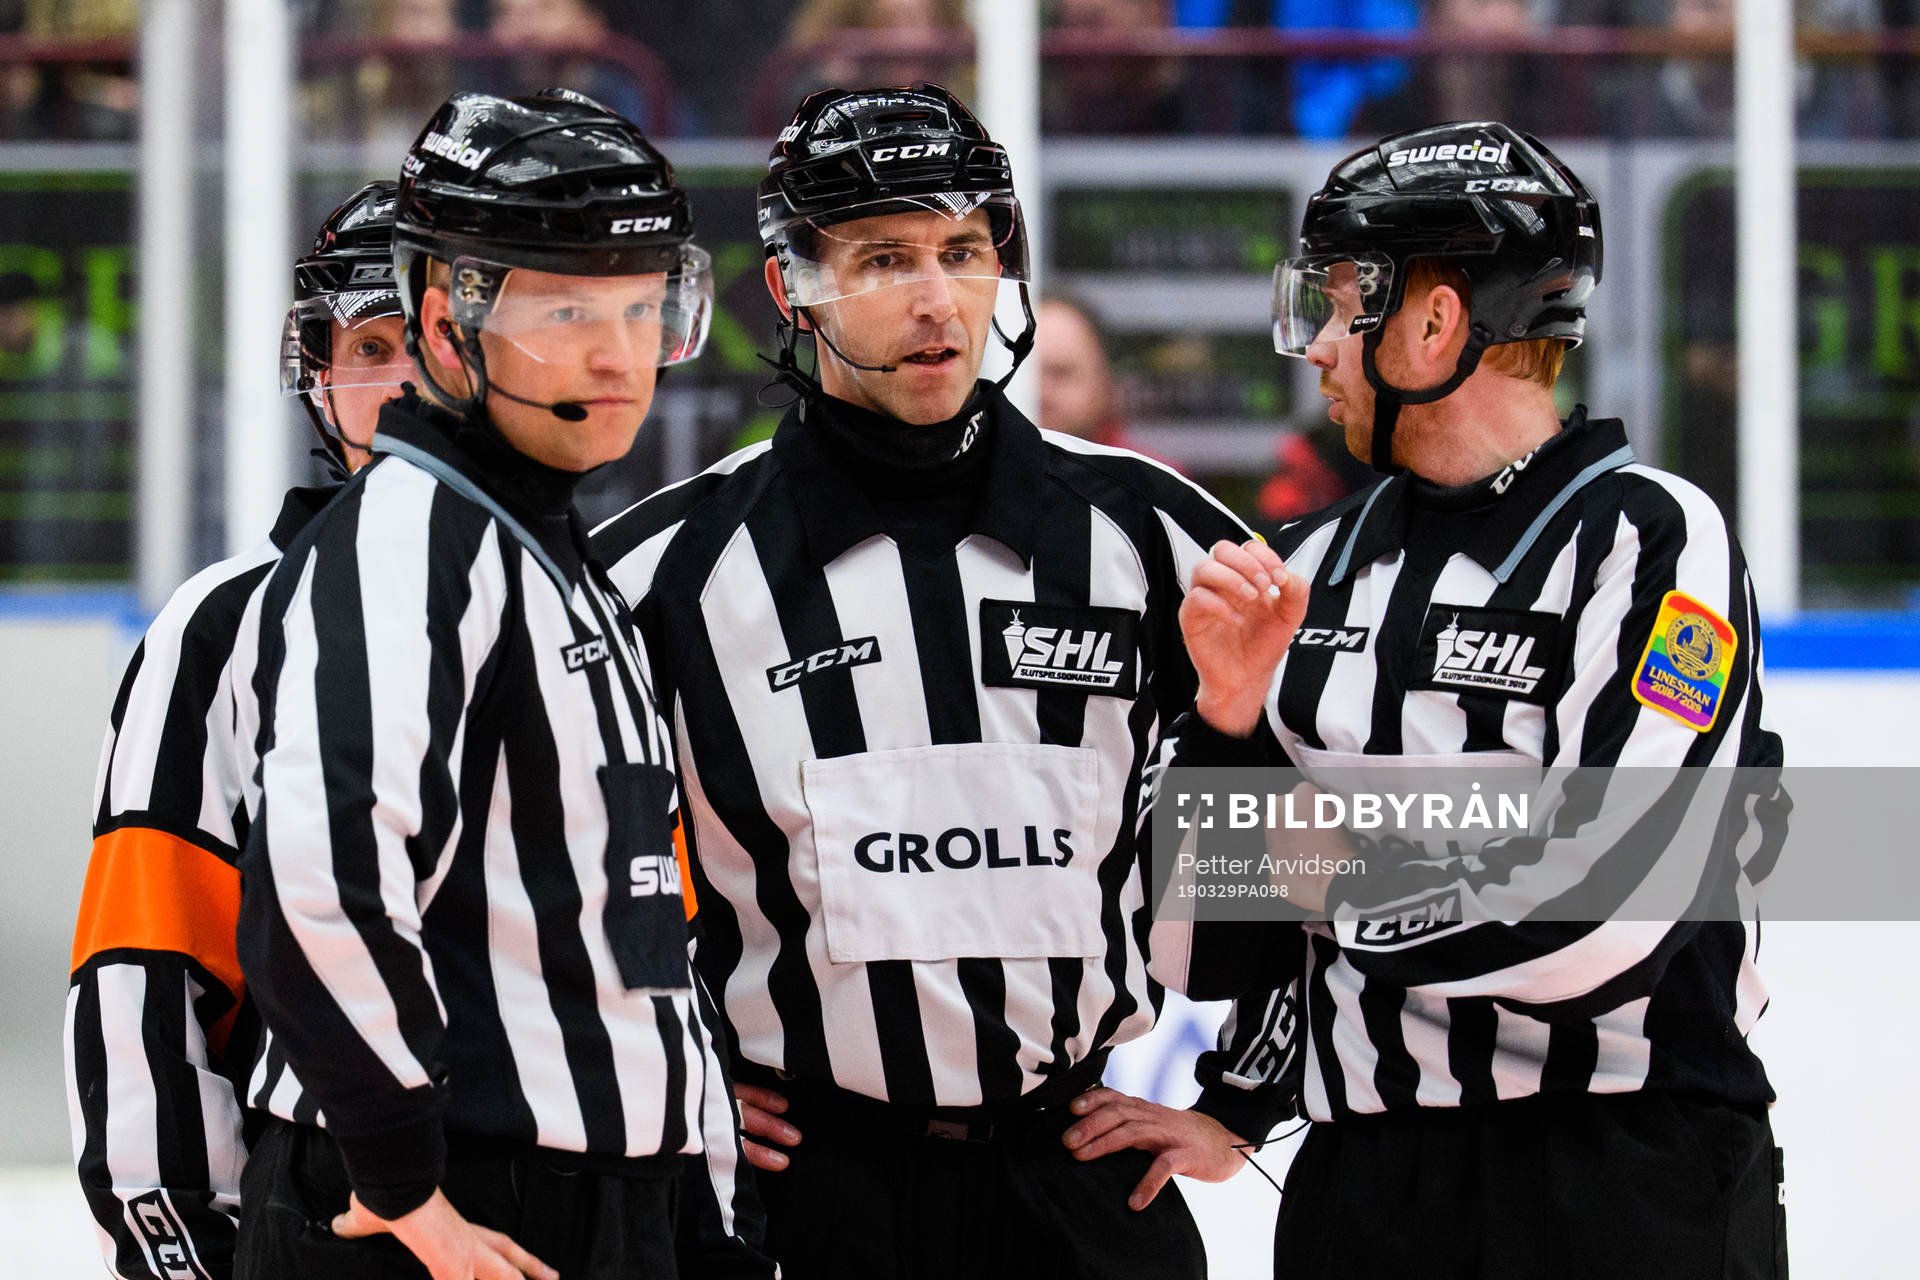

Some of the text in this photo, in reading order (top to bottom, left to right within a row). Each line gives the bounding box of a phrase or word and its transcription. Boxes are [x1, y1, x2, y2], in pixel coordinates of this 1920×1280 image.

[421, 131, 492, 171] swedol
[871, 143, 951, 162] CCM
[1387, 139, 1510, 168] swedol
[1464, 178, 1549, 194] CCM
[610, 216, 673, 235] CCM
[1354, 316, 1379, 325] CCM
[1020, 626, 1124, 672] SHL
[1288, 628, 1365, 649] CM
[1442, 630, 1546, 679] SHL
[773, 641, 874, 687] CCM
[1648, 666, 1711, 707] LINESMAN
[1650, 681, 1702, 714] 2018/2019
[854, 826, 1074, 874] GROLLS
[1360, 895, 1457, 941] CCM
[1244, 984, 1297, 1083] CC
